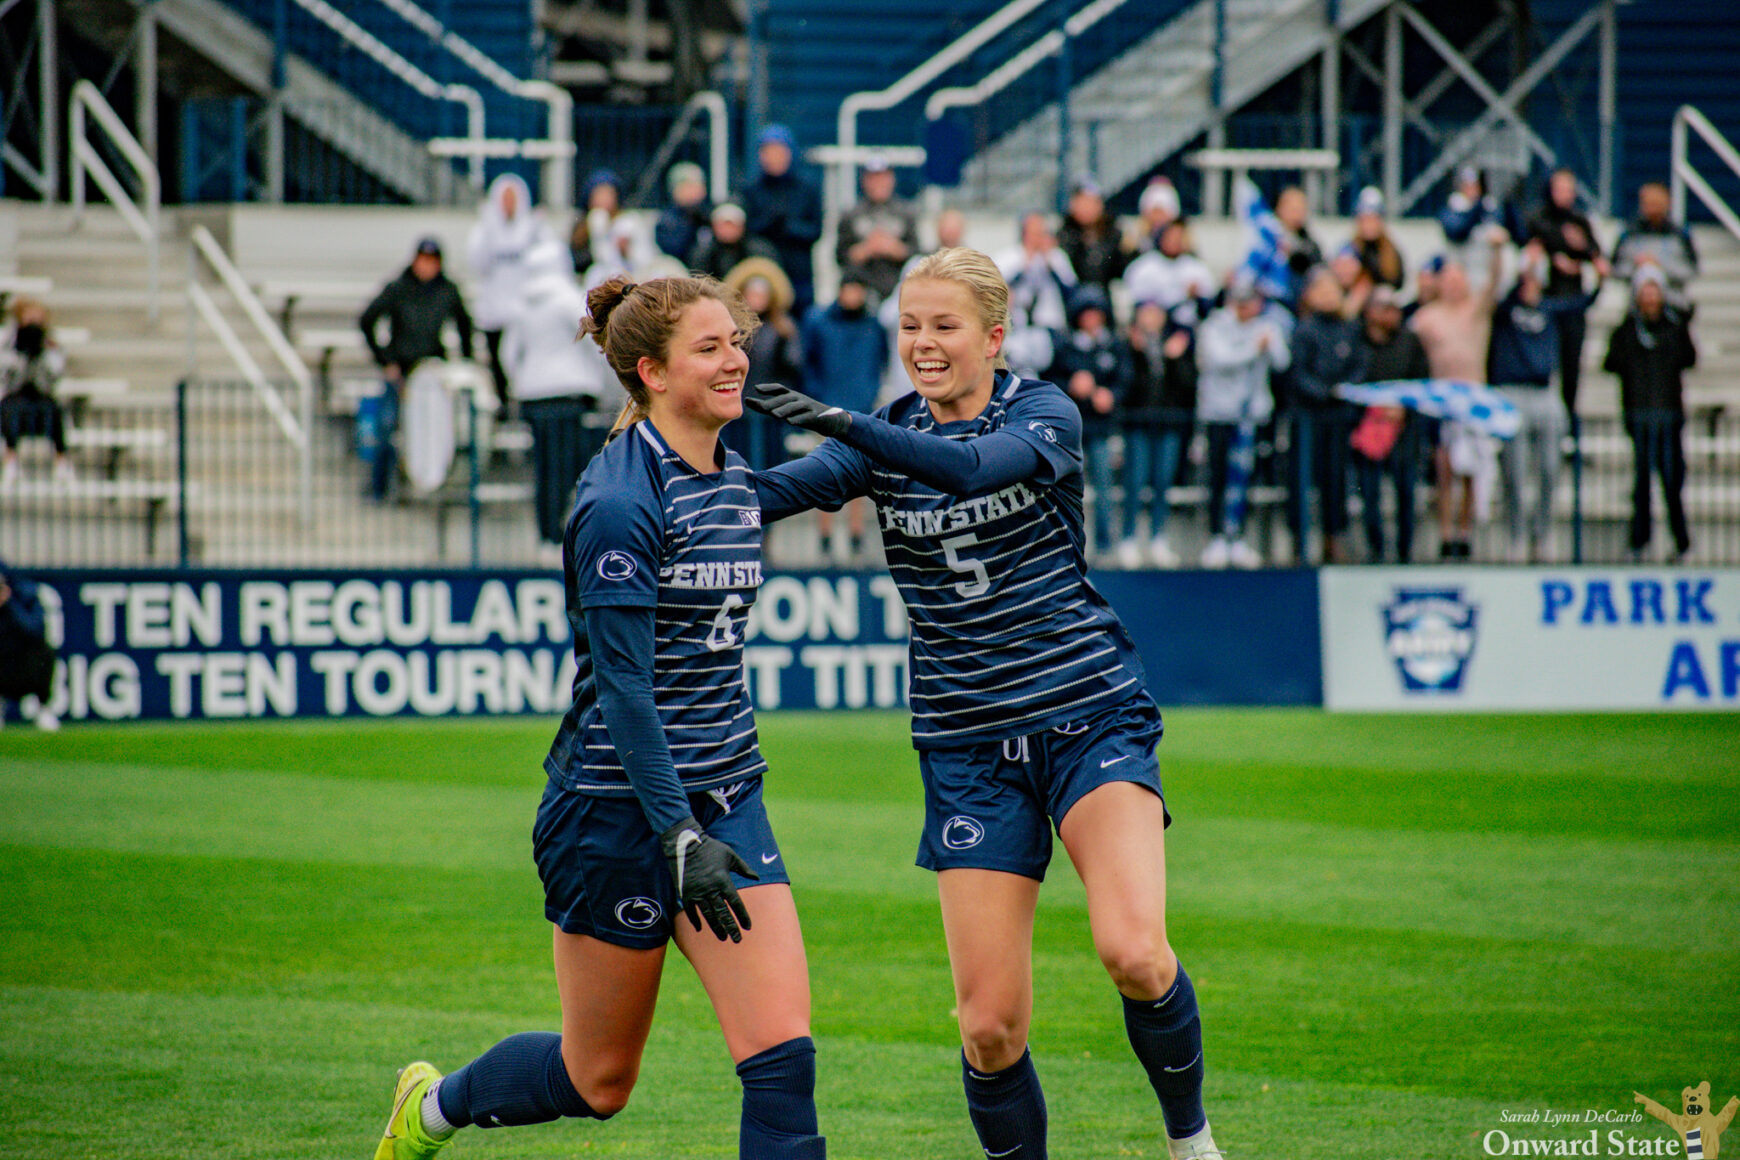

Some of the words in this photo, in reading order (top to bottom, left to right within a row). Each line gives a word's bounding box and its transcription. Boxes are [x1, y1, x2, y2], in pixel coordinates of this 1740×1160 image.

[940, 532, 991, 598] 5
[79, 582, 222, 648] TEN
[240, 578, 569, 646] REGULAR
[706, 594, 743, 652] 6
[1541, 580, 1716, 624] PARK
[155, 650, 298, 718] TEN
